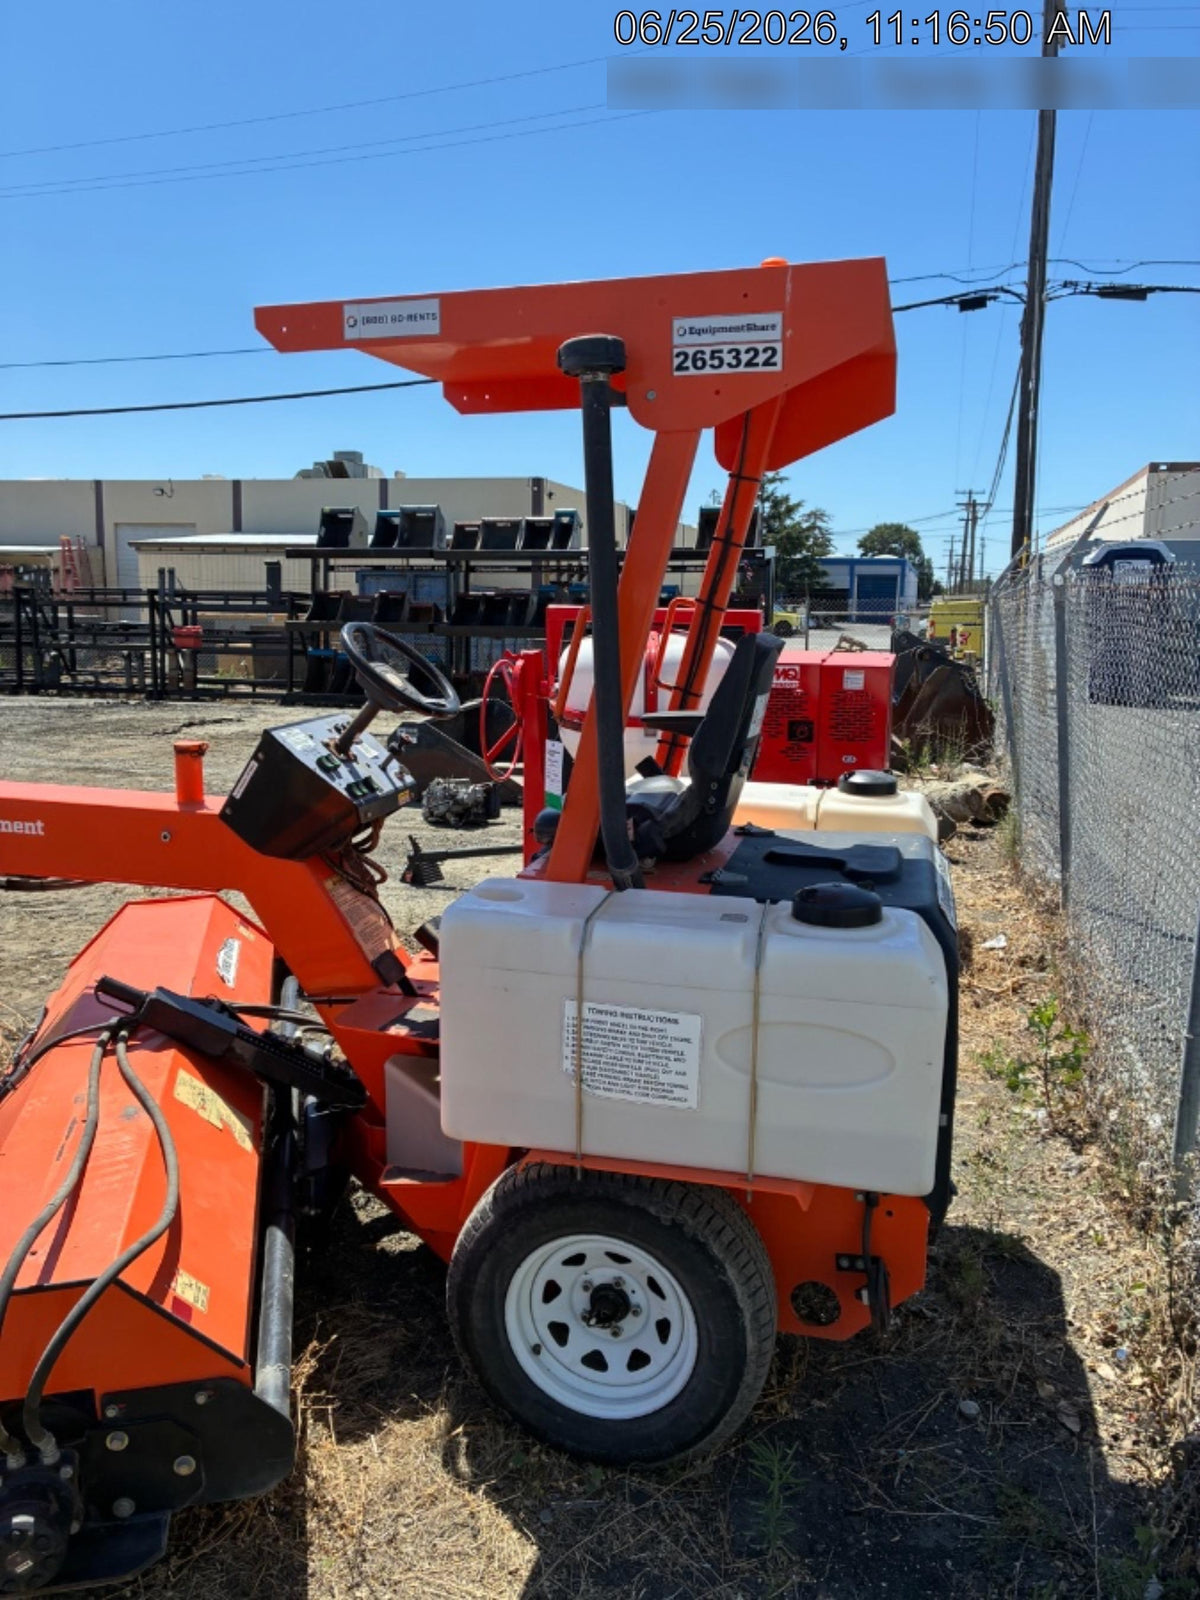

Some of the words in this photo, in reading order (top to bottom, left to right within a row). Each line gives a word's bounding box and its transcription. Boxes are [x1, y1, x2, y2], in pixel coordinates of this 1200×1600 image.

[688, 322, 777, 337] EquipmentShare
[674, 346, 778, 372] 265322
[587, 1008, 617, 1017] TOWING
[620, 1012, 679, 1024] INSTRUCTIONS
